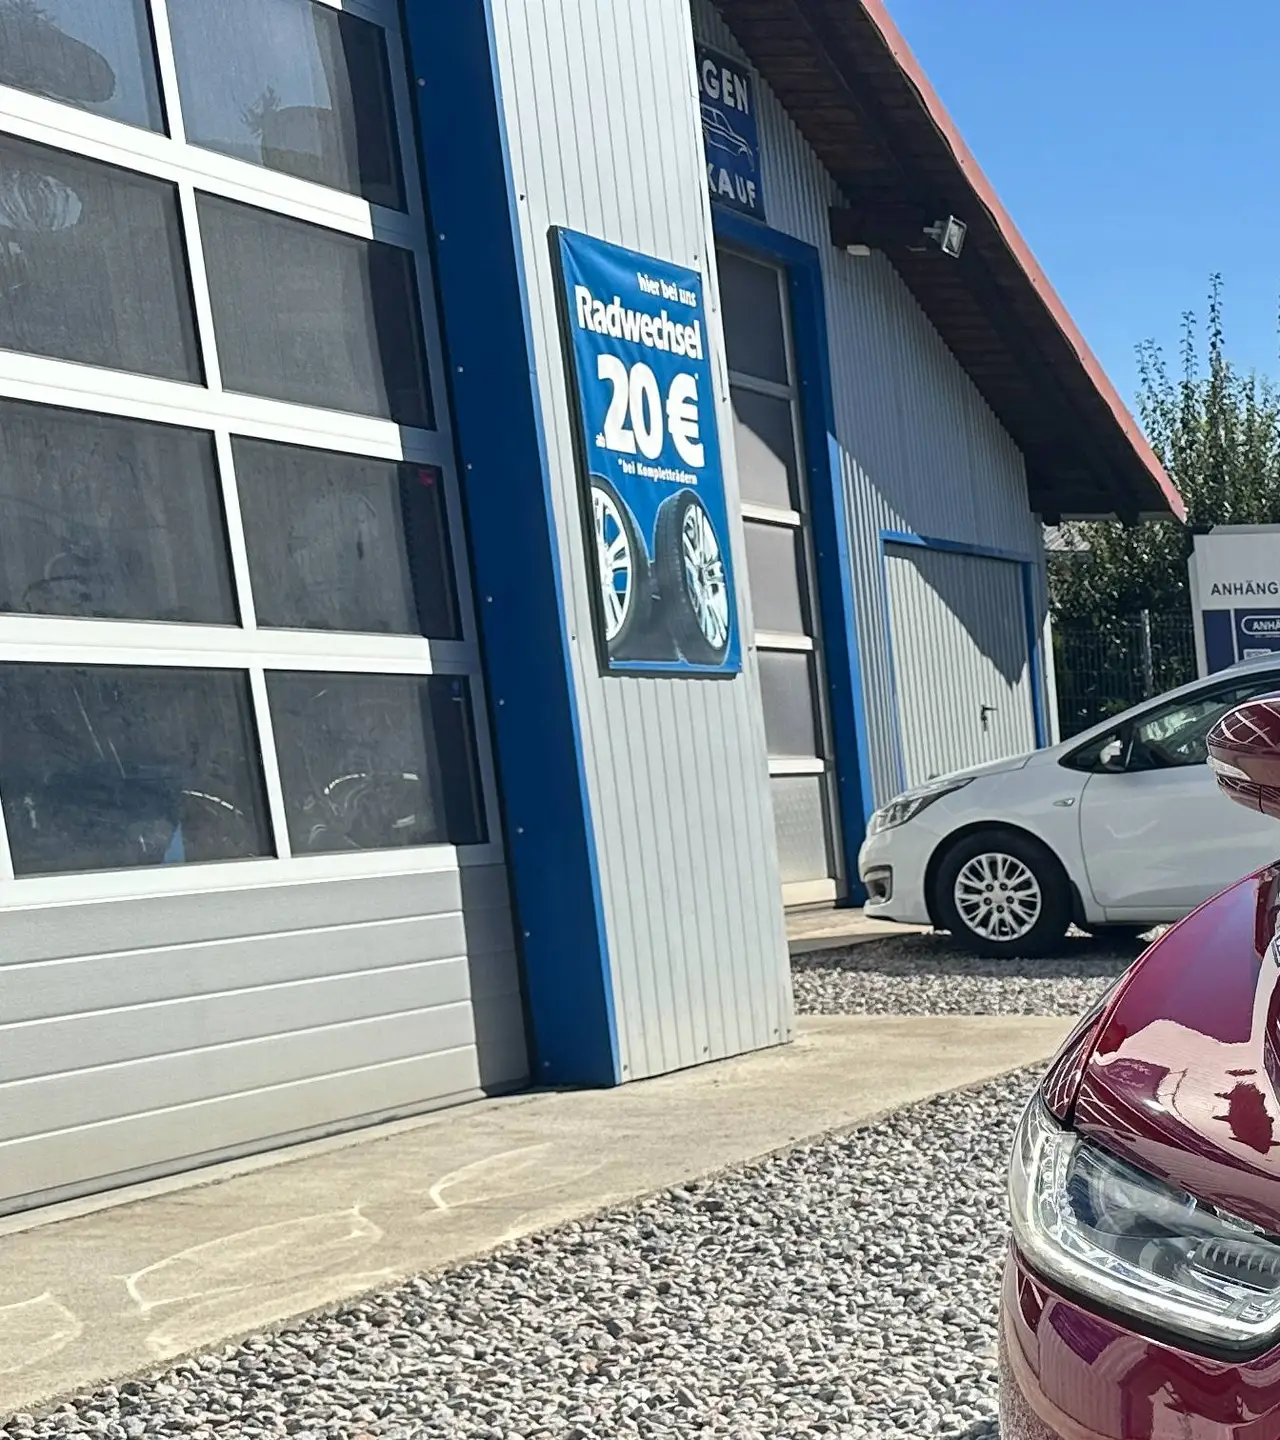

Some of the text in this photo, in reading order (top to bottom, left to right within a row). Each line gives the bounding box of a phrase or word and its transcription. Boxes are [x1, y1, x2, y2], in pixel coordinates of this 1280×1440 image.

[699, 59, 749, 115] GEN
[637, 271, 697, 307] hier bei uns
[574, 284, 704, 360] Radwechsel
